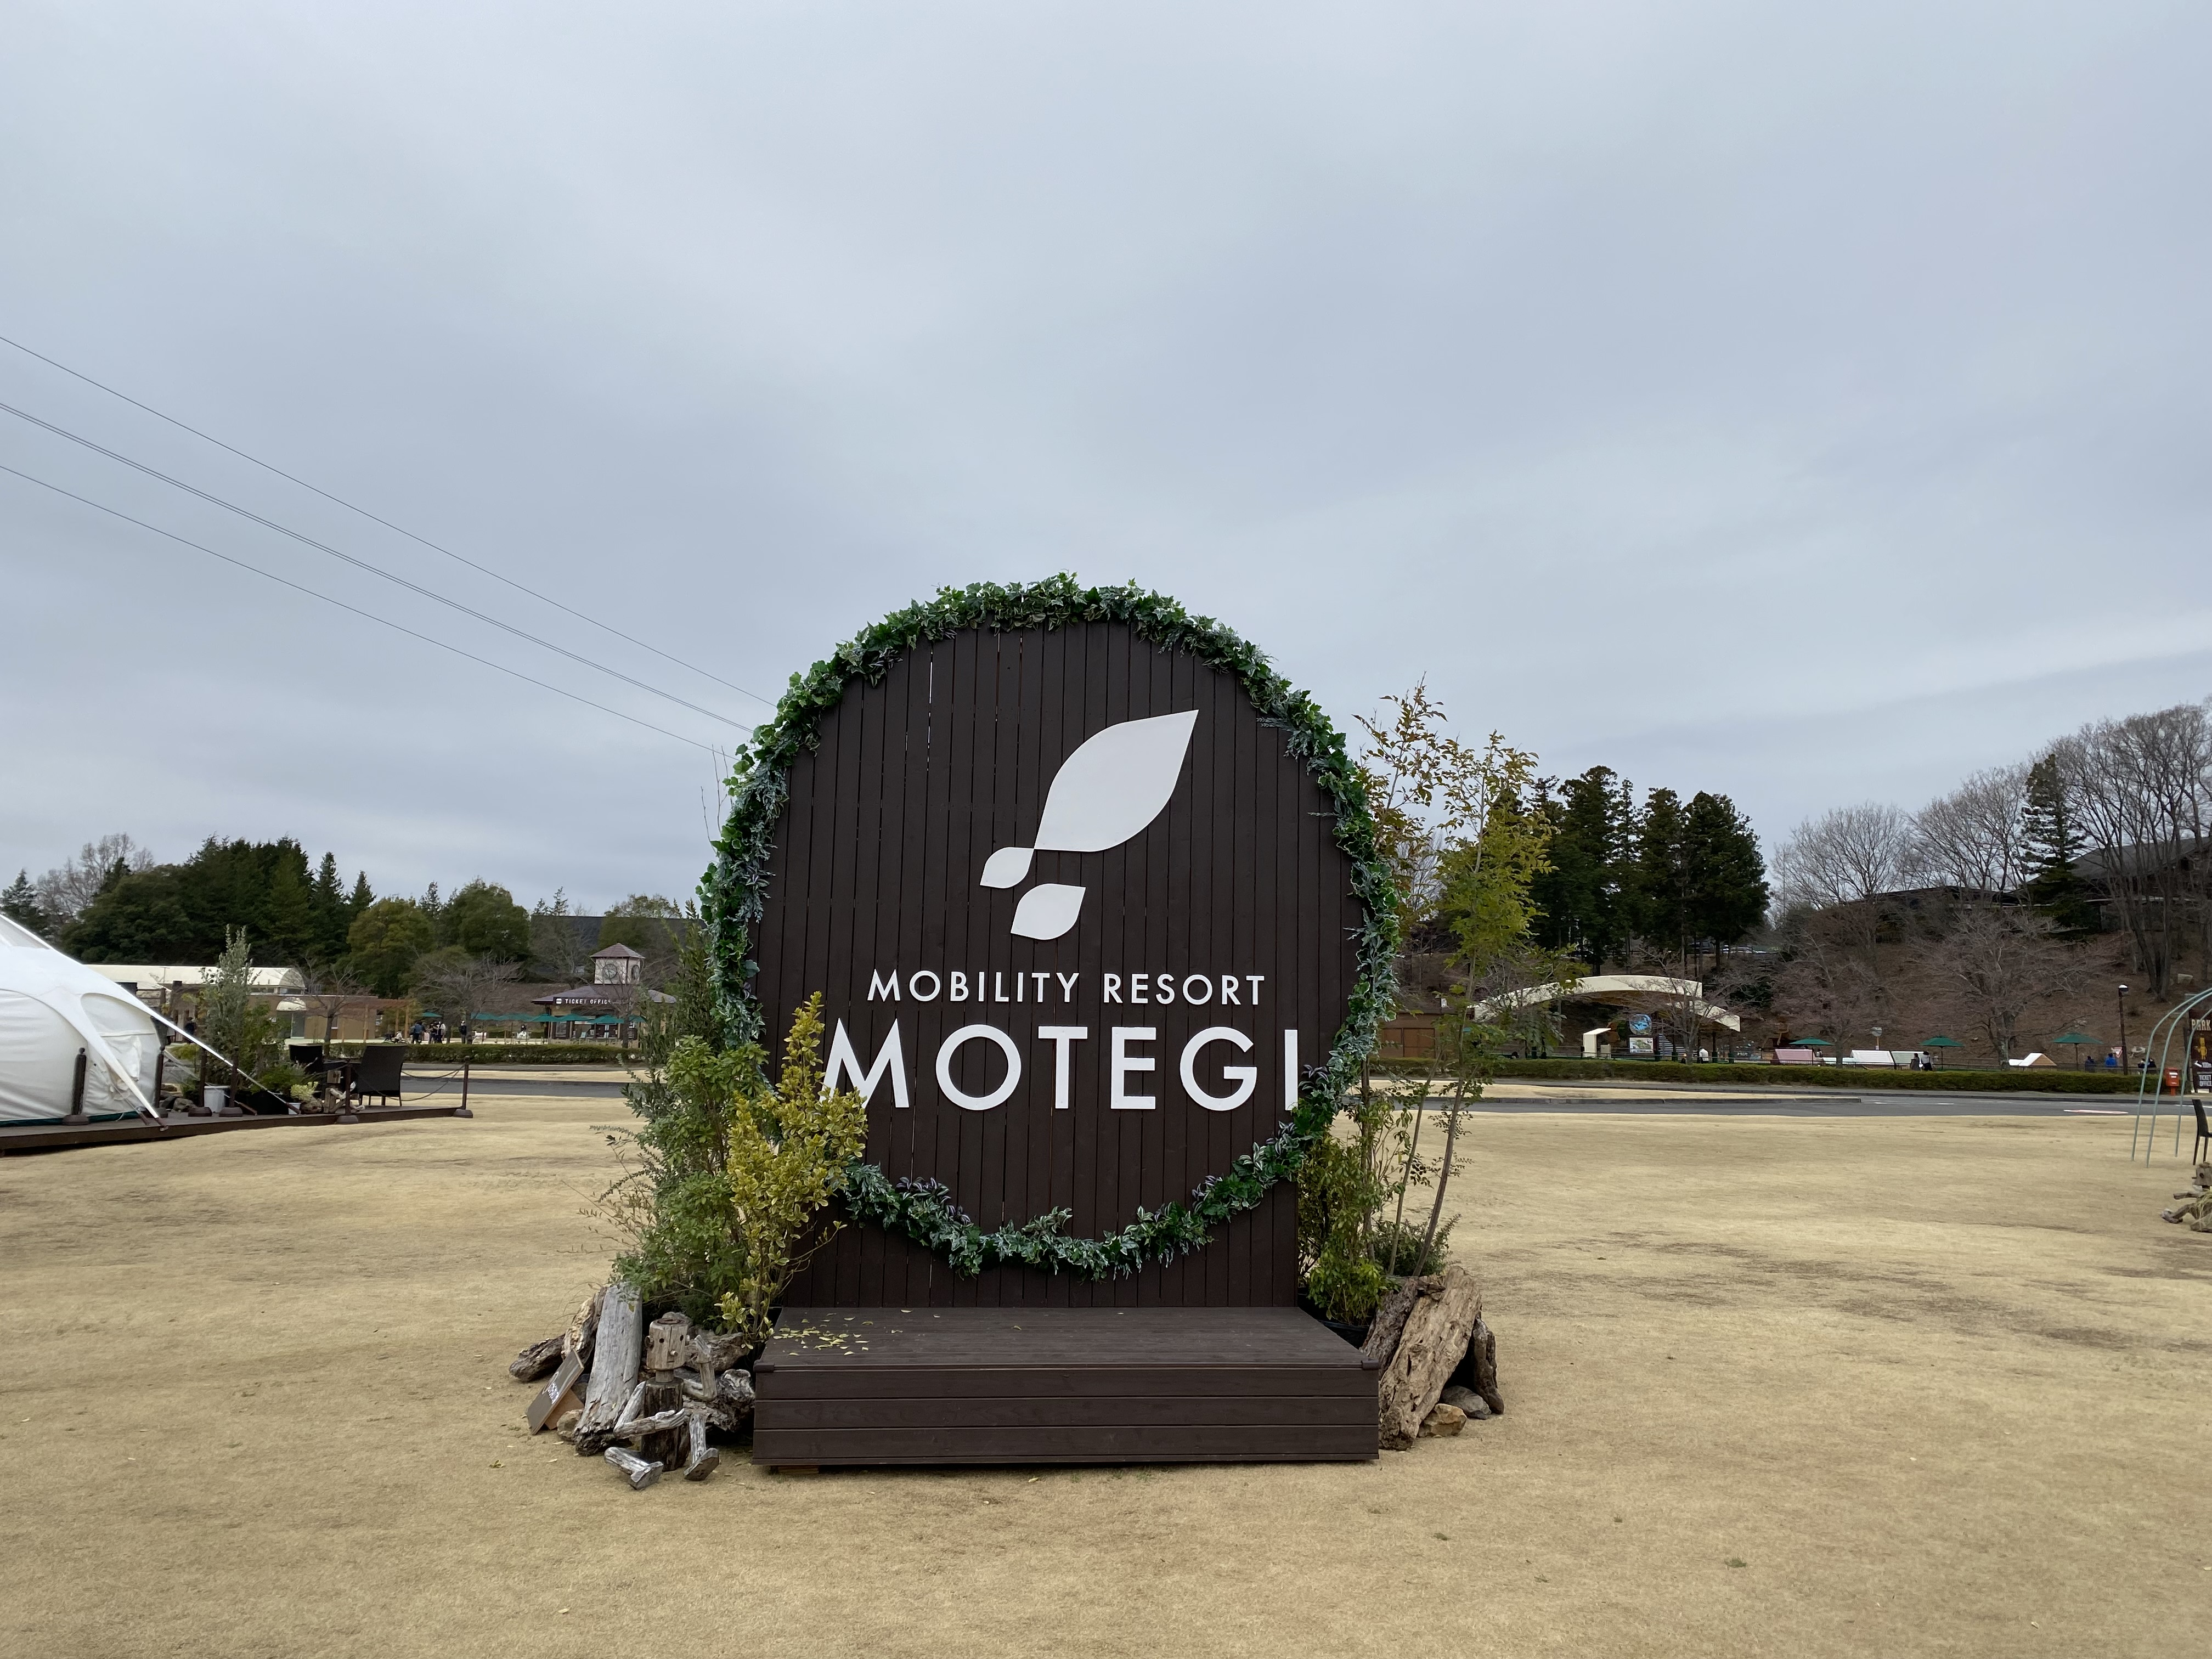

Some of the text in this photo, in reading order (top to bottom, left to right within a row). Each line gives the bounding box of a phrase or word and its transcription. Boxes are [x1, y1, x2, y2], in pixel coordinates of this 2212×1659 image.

[867, 968, 1265, 1005] MOBILITY RESORT
[2191, 1019, 2211, 1031] PARK
[819, 1018, 1299, 1111] MOTEGI
